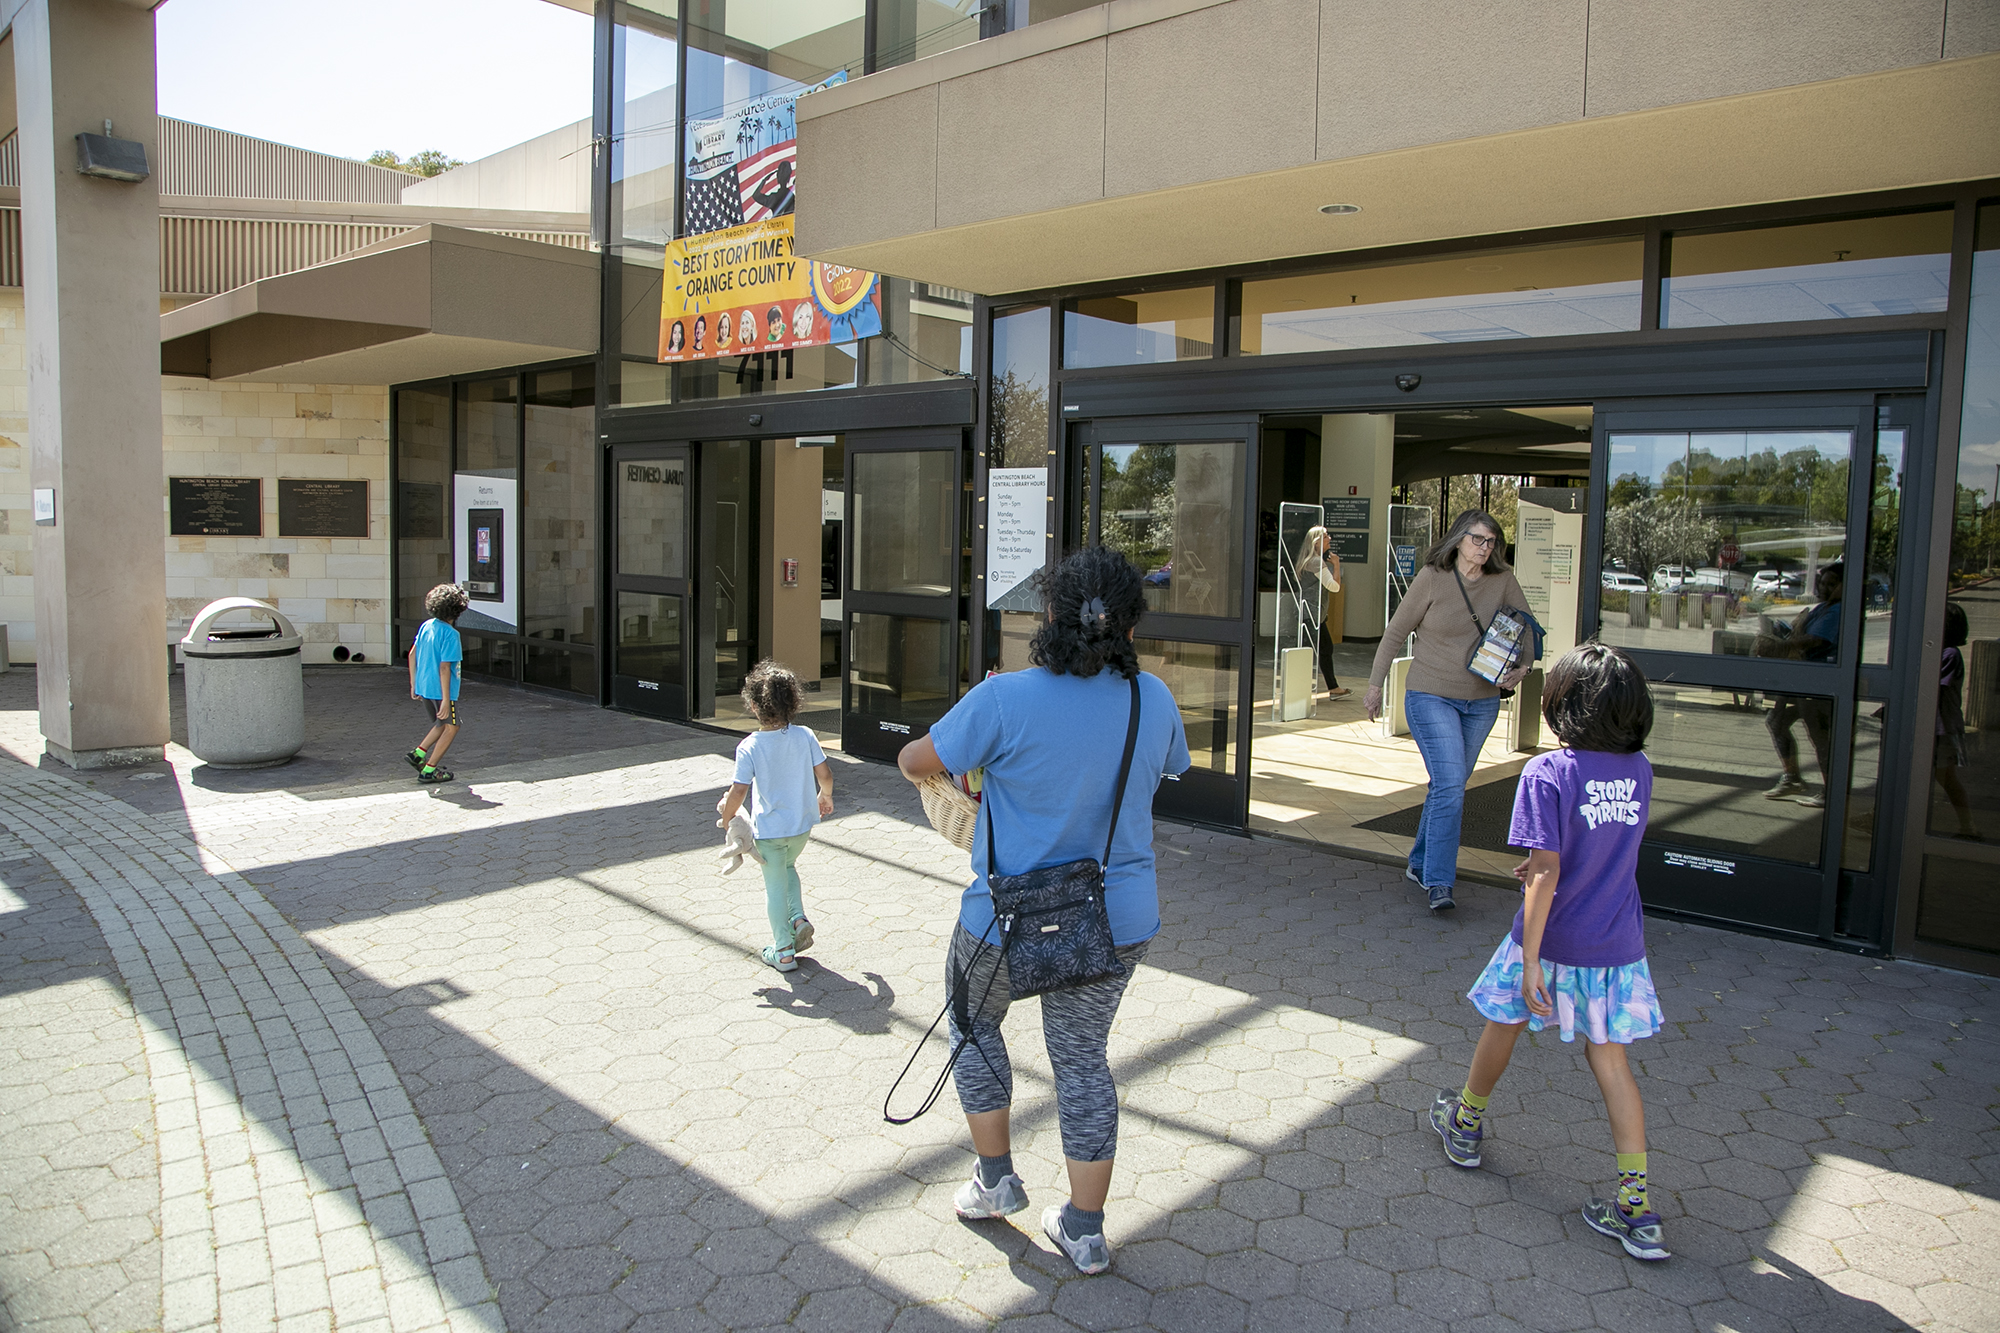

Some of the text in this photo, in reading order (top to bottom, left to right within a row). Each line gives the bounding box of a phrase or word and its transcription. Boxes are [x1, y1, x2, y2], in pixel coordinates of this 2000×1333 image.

[726, 102, 766, 120] ource
[704, 133, 725, 146] LIBRARY
[689, 245, 701, 254] 2022
[726, 237, 744, 248] Choice
[746, 232, 765, 243] Award
[767, 228, 790, 239] Winners
[690, 232, 723, 246] Huntington
[725, 228, 744, 240] Beach
[766, 220, 784, 231] Library
[682, 252, 709, 276] BEST
[713, 237, 783, 270] STORYTIME
[686, 261, 796, 298] ORANGE COUNTY
[826, 263, 858, 284] CHOIC
[833, 277, 853, 297] 2022
[734, 350, 794, 384] 7111
[479, 486, 494, 494] Returns
[1584, 778, 1637, 805] STORY
[1579, 800, 1642, 830] PIRATES
